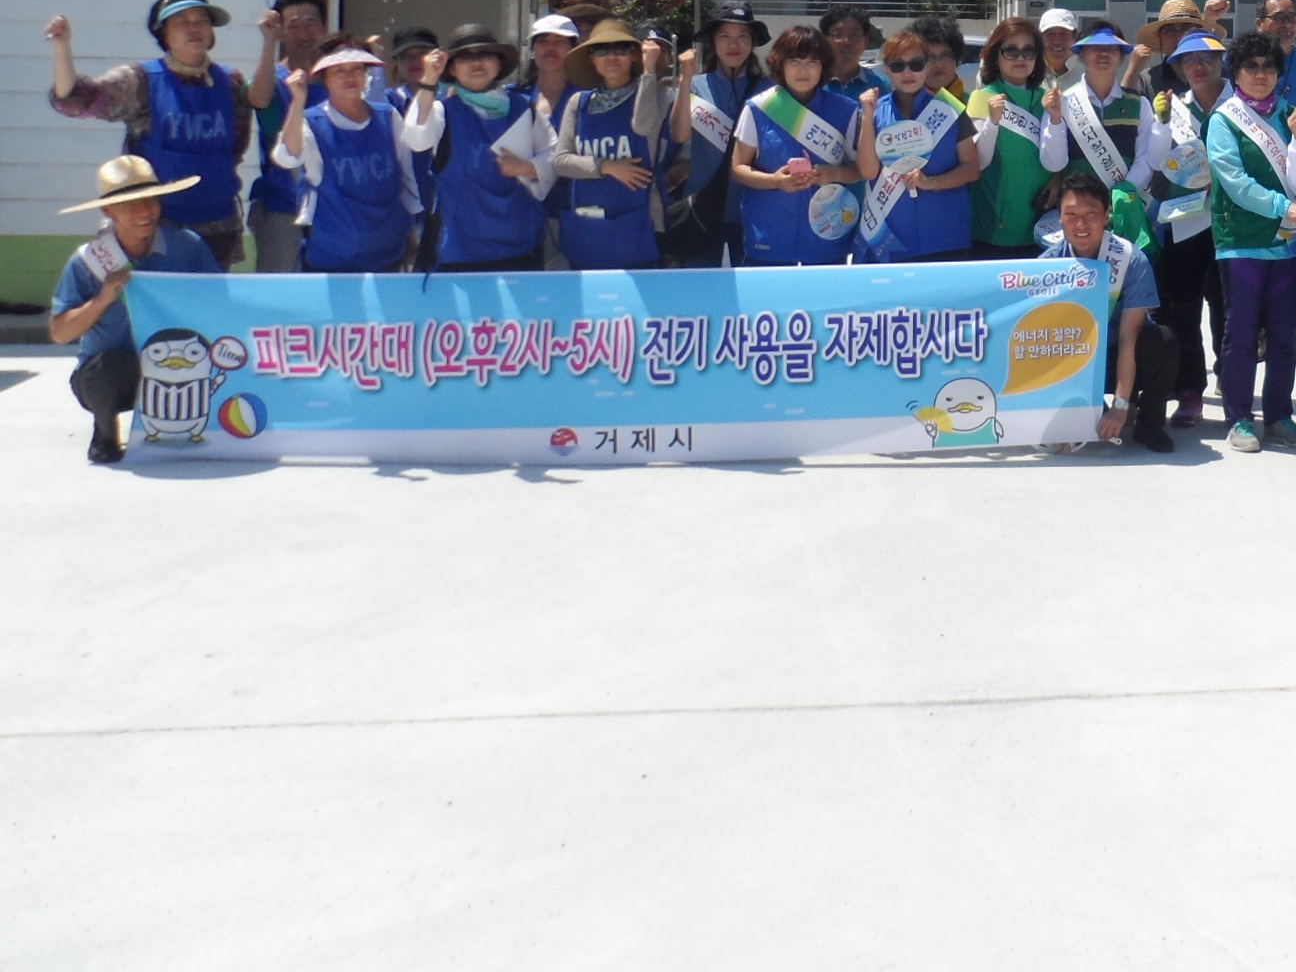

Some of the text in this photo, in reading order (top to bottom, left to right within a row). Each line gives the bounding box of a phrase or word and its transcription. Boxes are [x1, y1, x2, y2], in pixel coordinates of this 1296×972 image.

[167, 111, 228, 140] YWCA
[1081, 125, 1098, 144] 다시
[331, 154, 395, 185] YWCA
[879, 171, 906, 212] 자제합
[1000, 271, 1076, 289] Blue City
[1028, 288, 1058, 297] GEOJE
[1013, 328, 1083, 344] 에너지 절약?
[252, 308, 988, 389] 피크시간대 (오후2시~5시) 전기 사용을 자제합시다
[1014, 342, 1092, 360] 할 만하더라고!
[595, 426, 693, 454] 거제시
